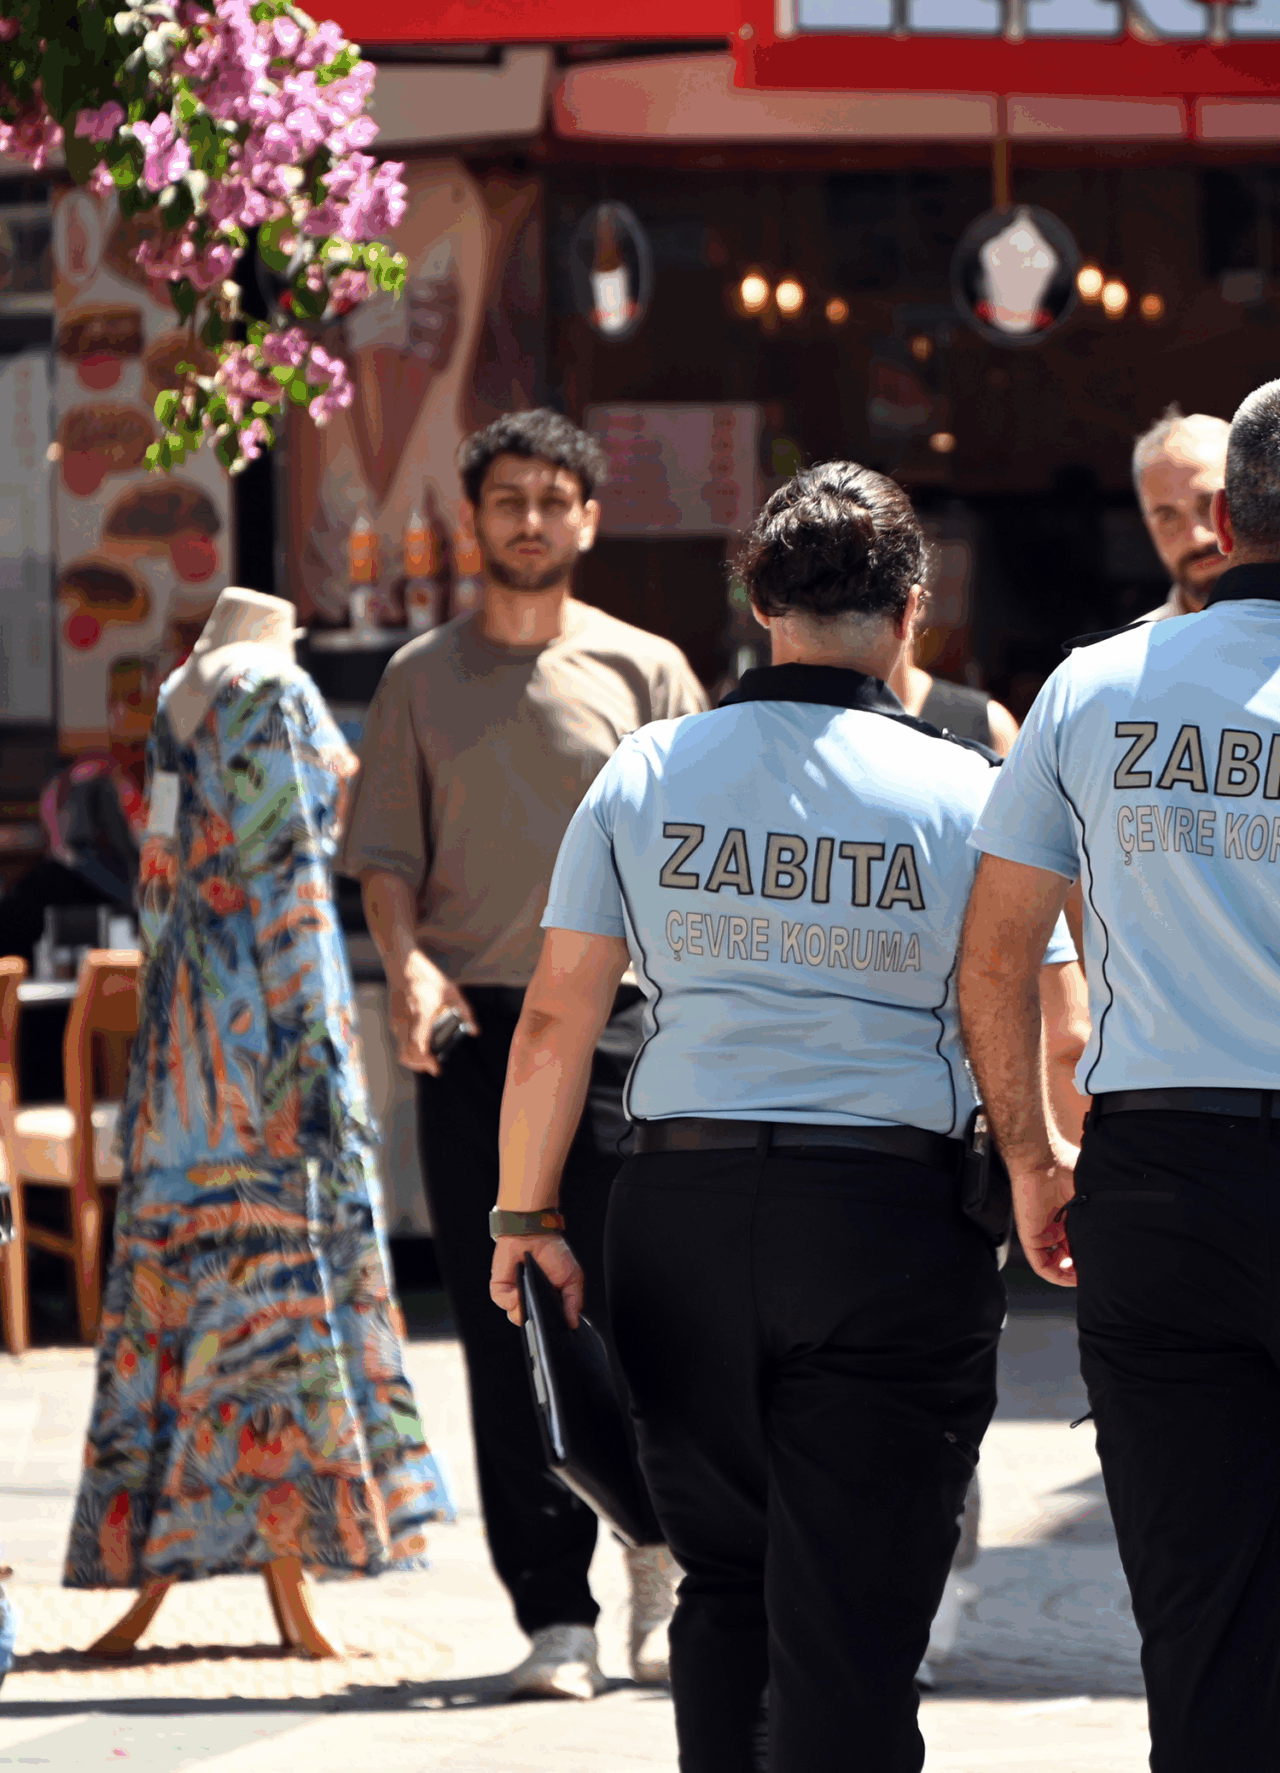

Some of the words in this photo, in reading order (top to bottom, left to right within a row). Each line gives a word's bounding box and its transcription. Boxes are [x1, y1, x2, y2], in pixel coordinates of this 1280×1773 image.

[659, 822, 926, 911] ZABITA
[1116, 805, 1216, 866] ÇEVRE
[665, 909, 769, 962] ÇEVRE
[781, 921, 921, 973] KORUMA
